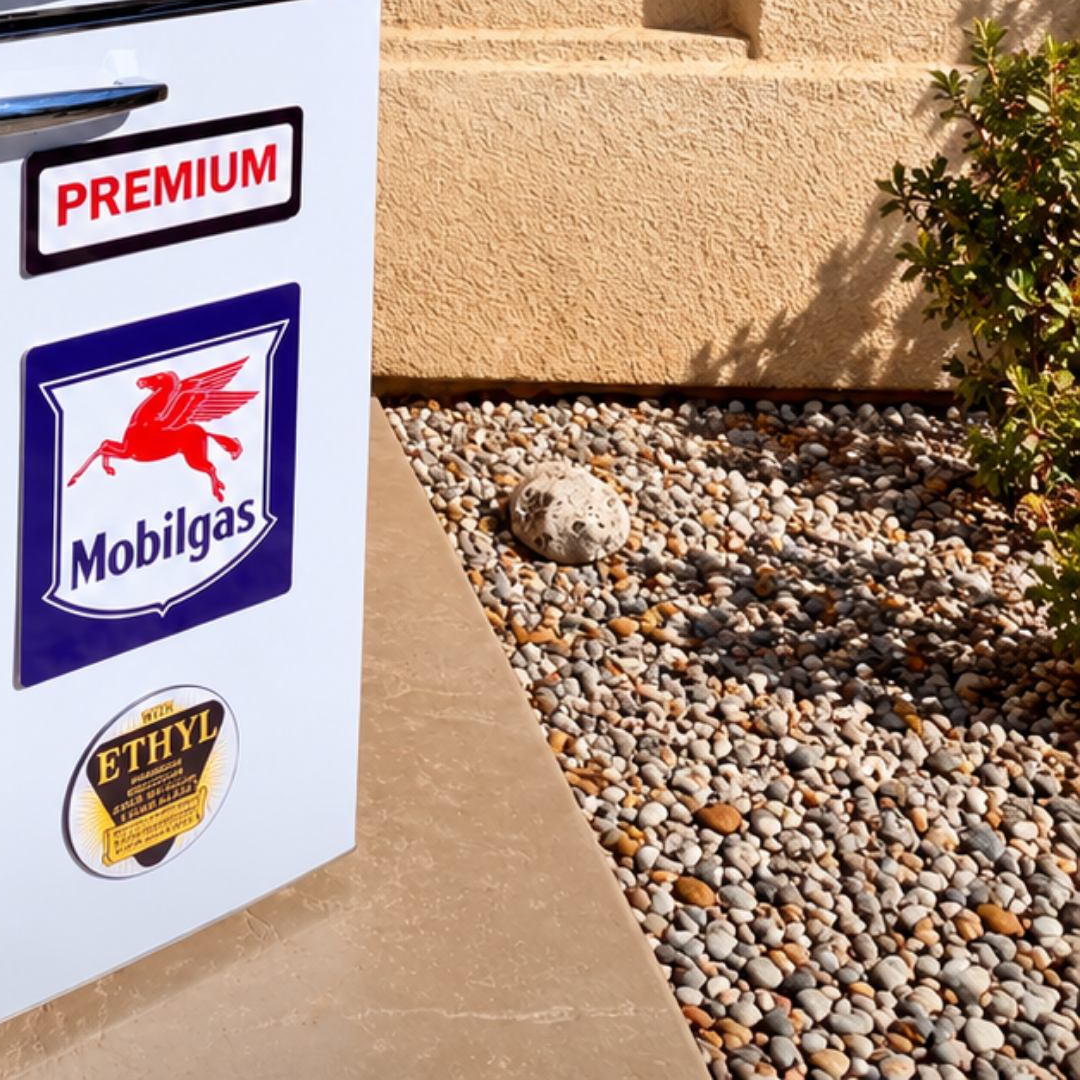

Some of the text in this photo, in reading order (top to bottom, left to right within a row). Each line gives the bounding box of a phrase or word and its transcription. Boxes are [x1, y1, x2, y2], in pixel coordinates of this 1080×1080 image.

[58, 144, 276, 226] PREMIUM
[71, 499, 255, 590] Mobilgas
[96, 709, 218, 786] ETHYL
